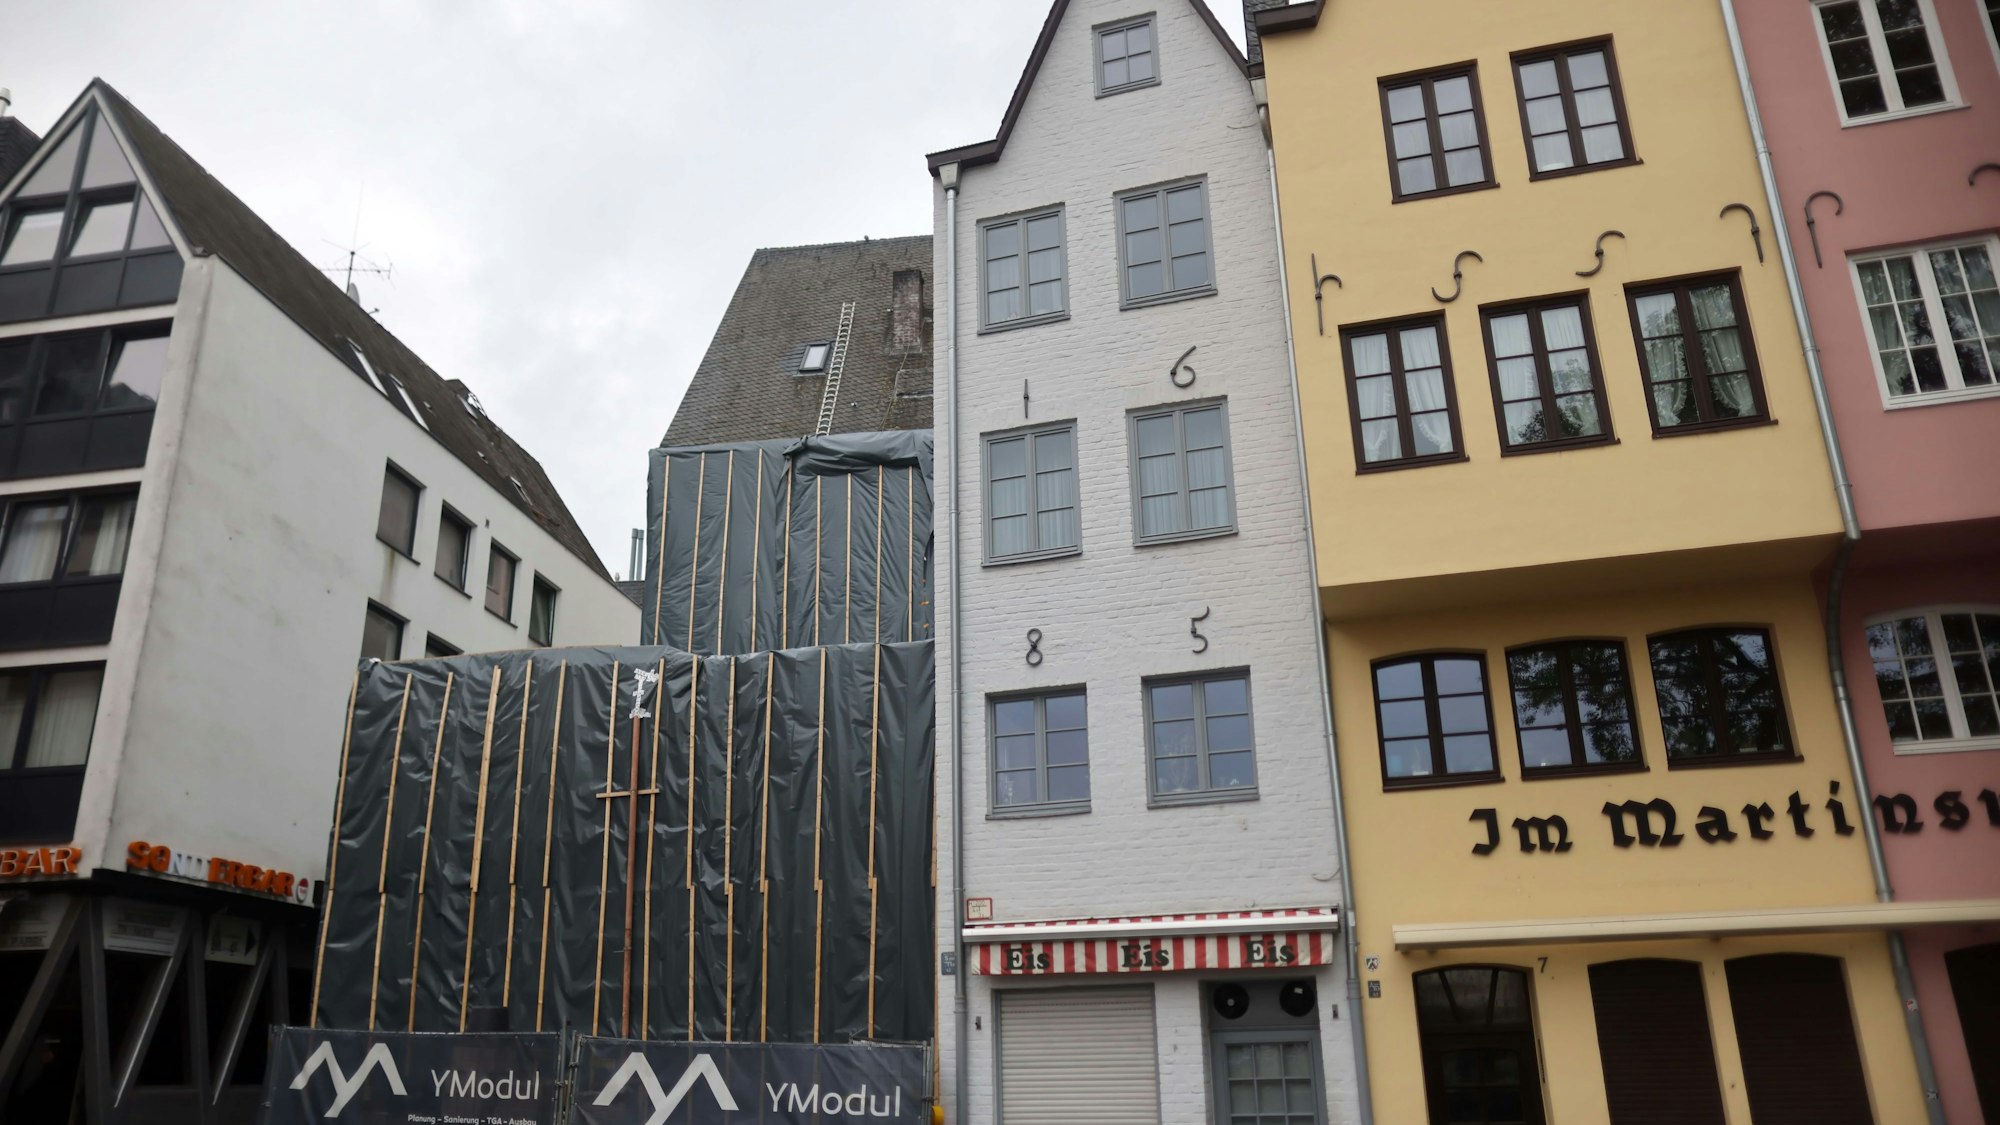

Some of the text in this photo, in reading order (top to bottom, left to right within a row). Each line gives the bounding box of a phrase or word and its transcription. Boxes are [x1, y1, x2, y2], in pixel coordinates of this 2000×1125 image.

[1170, 345, 1197, 388] 6
[1025, 606, 1211, 667] 8 5
[126, 840, 296, 898] SONDERBAR
[1005, 939, 1296, 971] Eis Eis Eis
[1536, 956, 1549, 974] 7
[431, 1069, 540, 1100] YModul
[765, 1082, 901, 1117] YModul
[407, 1114, 537, 1125] Planung Sanierung TGA Ausbau
